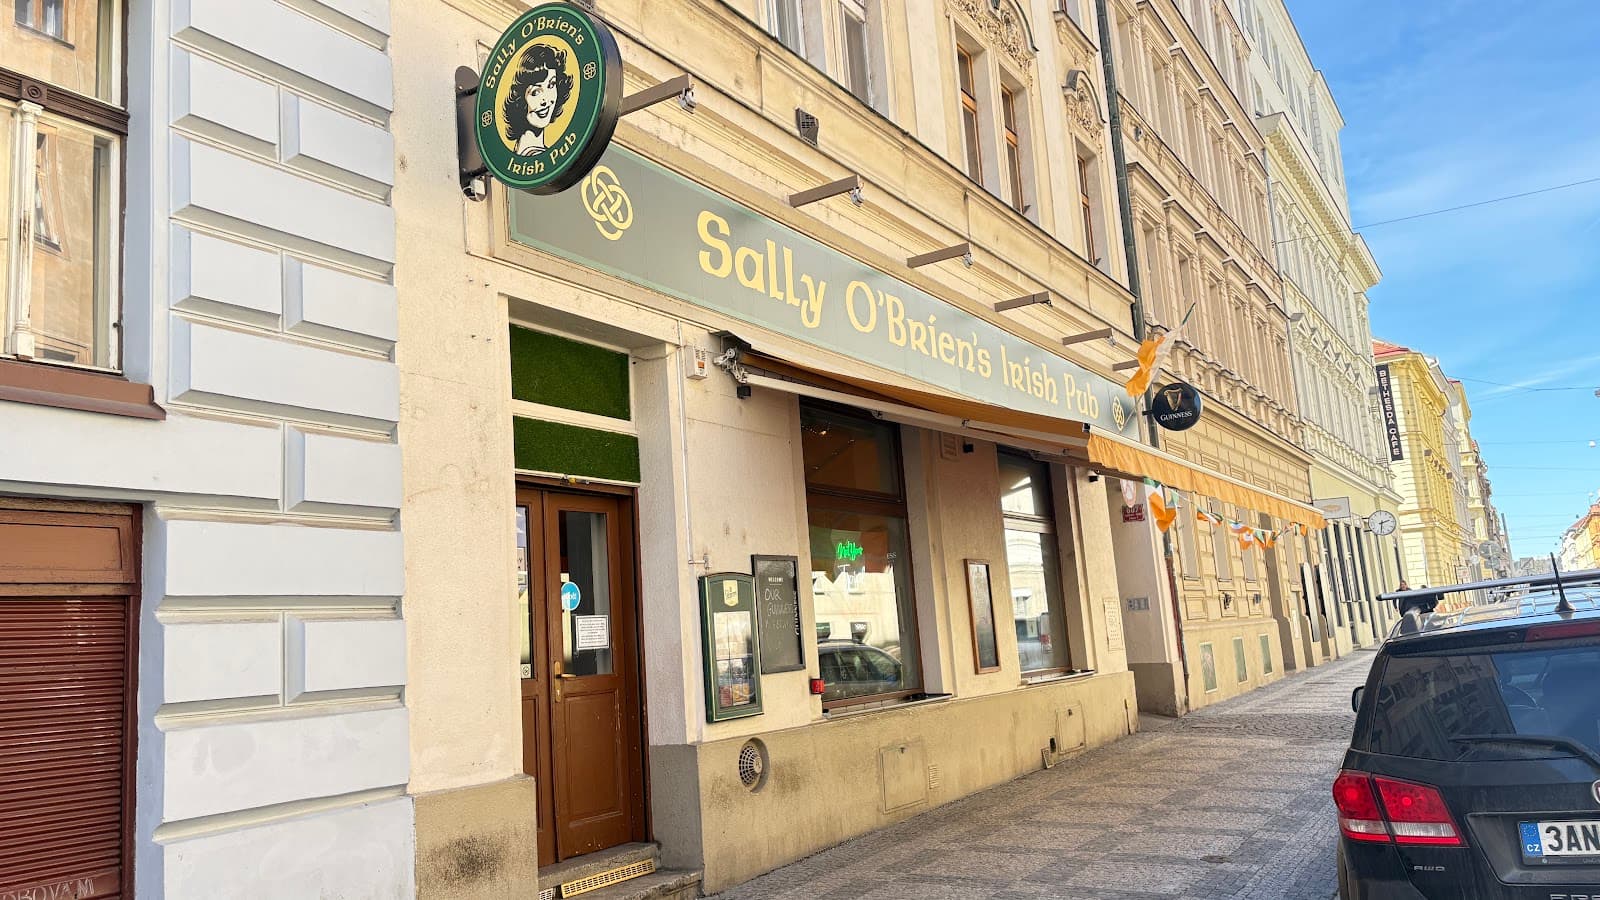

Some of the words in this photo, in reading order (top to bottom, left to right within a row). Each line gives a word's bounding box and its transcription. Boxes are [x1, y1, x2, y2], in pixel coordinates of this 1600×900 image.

[486, 38, 518, 90] Sally
[521, 16, 585, 46] O'Brien's
[507, 157, 546, 176] Irish
[550, 132, 577, 165] Pub
[697, 210, 827, 329] Sally
[845, 280, 993, 379] O'Brien's
[1000, 344, 1058, 405] Irish
[1064, 375, 1099, 420] Pub
[1160, 410, 1193, 421] GUINNESS
[1379, 370, 1395, 425] BETHESDA
[1389, 428, 1400, 455] CAFE
[1413, 864, 1446, 872] AWD
[1526, 844, 1541, 852] CZ
